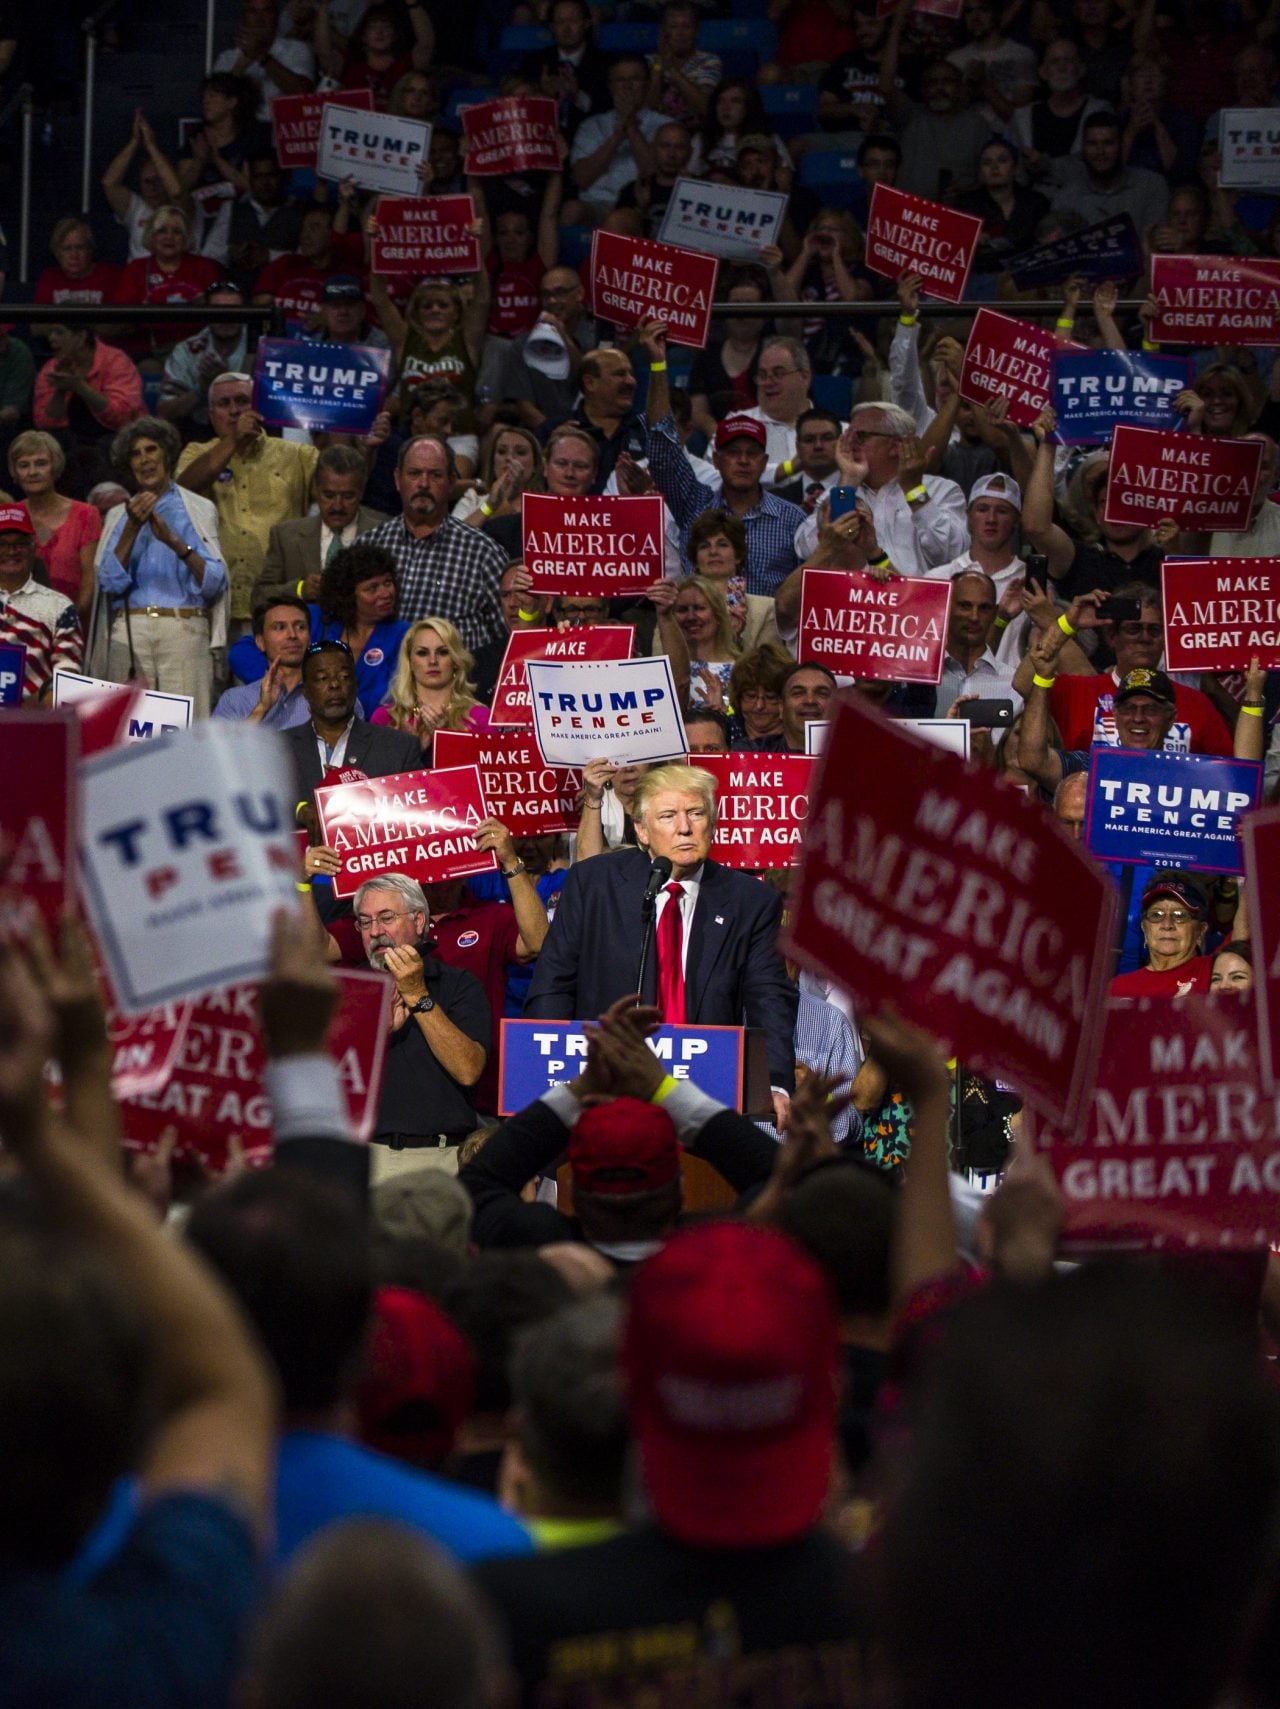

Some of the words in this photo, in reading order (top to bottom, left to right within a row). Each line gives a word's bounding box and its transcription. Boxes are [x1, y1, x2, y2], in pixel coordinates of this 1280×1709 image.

[329, 126, 421, 155] TRUMP
[472, 120, 558, 151] AMERICA
[333, 143, 409, 167] PENCE
[403, 209, 439, 222] MAKE
[679, 200, 775, 228] TRUMP
[901, 208, 941, 232] MAKE
[376, 223, 471, 246] AMERICA
[682, 215, 762, 239] PENCE
[381, 246, 420, 260] GREAT
[424, 244, 470, 259] AGAIN
[870, 217, 968, 270] AMERICA
[632, 253, 674, 276] MAKE
[873, 243, 908, 271] GREAT
[908, 258, 957, 285] AGAIN
[1196, 269, 1242, 283] MAKE
[595, 264, 708, 312] AMERICA
[1157, 286, 1280, 311] AMERICA
[602, 292, 645, 316] GREAT
[646, 303, 697, 328] AGAIN
[1162, 312, 1215, 328] GREAT
[1219, 313, 1273, 329] AGAIN
[1013, 336, 1051, 361] MAK
[265, 361, 379, 387] TRUMP
[967, 343, 1051, 392] AMERI
[272, 380, 366, 400] PENCE
[970, 371, 1018, 400] GREAT
[1058, 375, 1185, 395] TRUMP
[1067, 395, 1169, 410] PENCE
[1085, 410, 1117, 418] AMERICA
[1161, 448, 1211, 467] MAKE
[1113, 461, 1251, 497] AMERICA
[1120, 491, 1177, 514] GREAT
[1181, 496, 1240, 515] AGAIN
[564, 512, 612, 528] MAKE
[524, 532, 660, 557] AMERICA
[532, 558, 587, 576] GREAT
[591, 560, 651, 577] AGAIN
[1216, 576, 1271, 592] MAKE
[849, 588, 898, 607] MAKE
[803, 605, 941, 641] AMERICA
[1167, 599, 1280, 627] AMERI
[545, 641, 587, 656] MAKE
[811, 636, 867, 657] GREAT
[870, 642, 929, 662] AGAIN
[1179, 631, 1243, 649] GREAT
[539, 688, 665, 712] TRUMP
[551, 712, 655, 729] PENCE
[604, 731, 630, 739] GREAT
[633, 727, 662, 737] AGAIN!
[479, 749, 531, 766] MAKE
[484, 769, 583, 796] ERICA
[729, 771, 784, 787] MAKE
[375, 788, 428, 809] MAKE
[512, 798, 575, 816] AGAIN
[717, 794, 810, 821] MERIC
[1099, 779, 1251, 813] TRUMP
[333, 803, 482, 853] AMERICA
[1110, 805, 1233, 830] PENCE
[99, 793, 281, 868] TRU
[710, 827, 755, 845] REAT
[759, 827, 803, 845] AGA
[916, 788, 1038, 878] MAKE
[1104, 823, 1130, 832] MAKE
[1131, 825, 1171, 836] AMERICA
[1173, 829, 1202, 839] GREAT
[1203, 832, 1236, 842] AGAIN!
[345, 847, 409, 874] GREAT
[414, 835, 478, 861] AGAIN
[1154, 858, 1182, 868] 2016
[935, 953, 1069, 1063] AGAIN
[533, 1032, 709, 1061] TRMP
[1150, 1028, 1251, 1072] MAK
[1062, 1151, 1217, 1200] GREAT
